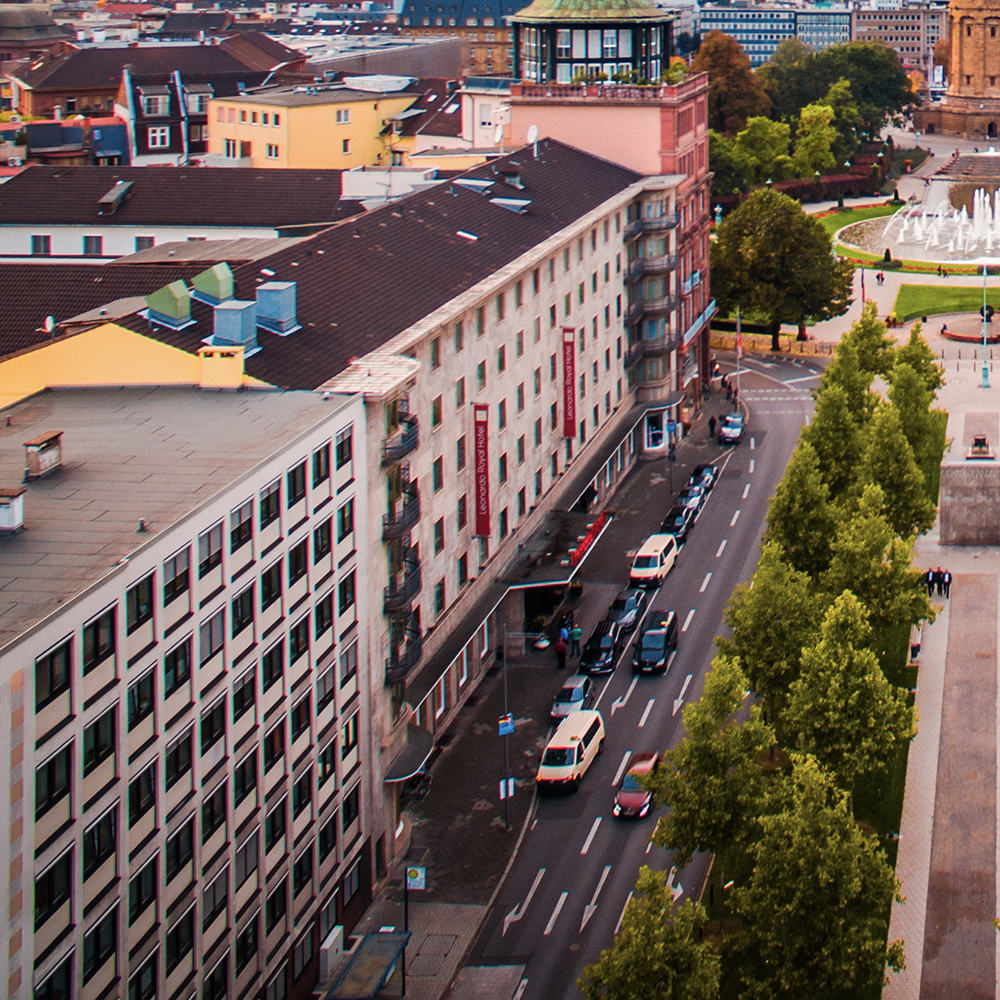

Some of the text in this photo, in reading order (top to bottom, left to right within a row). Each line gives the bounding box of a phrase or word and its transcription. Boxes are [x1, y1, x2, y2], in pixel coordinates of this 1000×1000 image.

[565, 365, 573, 385] Royal
[565, 386, 574, 420] Leonardo
[477, 425, 487, 514] Leonardo Royal Hotel
